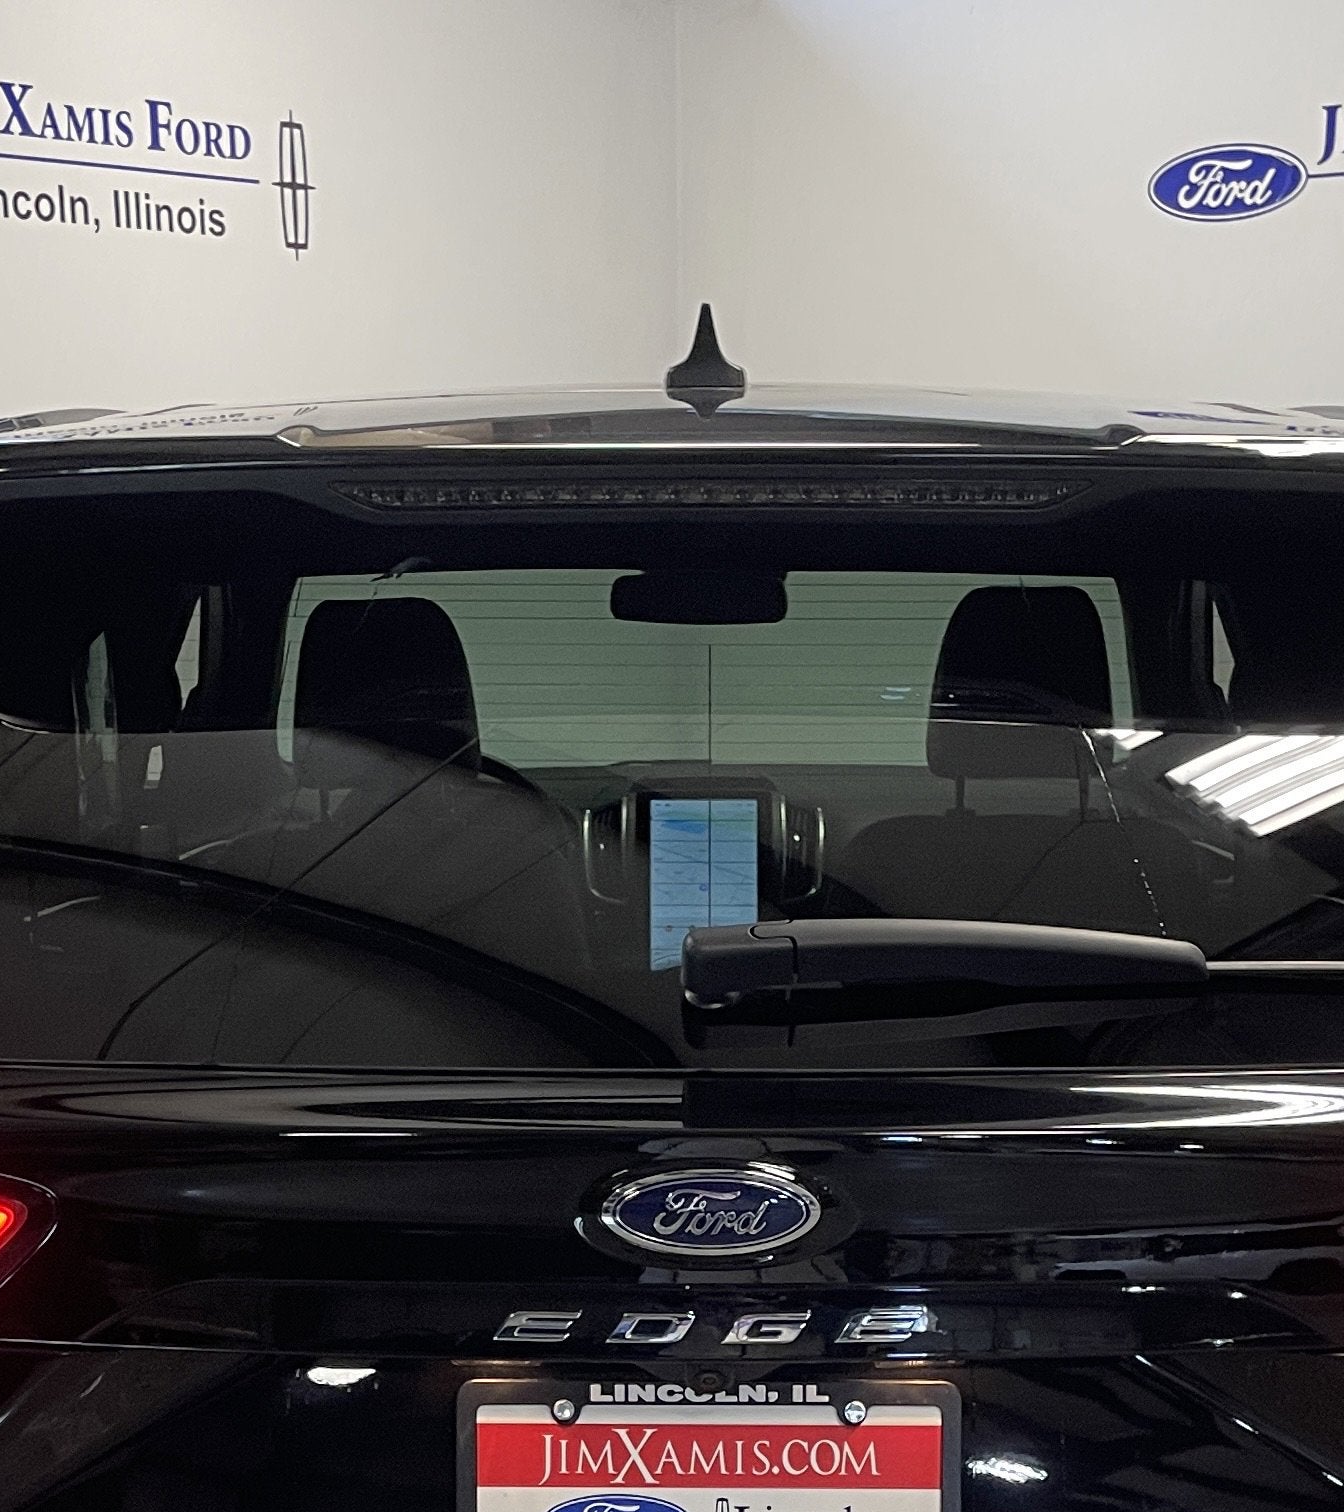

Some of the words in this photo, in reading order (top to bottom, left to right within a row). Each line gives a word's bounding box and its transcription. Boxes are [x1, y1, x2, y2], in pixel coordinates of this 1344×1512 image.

[144, 99, 252, 160] FORD
[1177, 158, 1275, 209] Ford
[113, 189, 226, 237] Illinois
[653, 1189, 776, 1236] Ford
[492, 1305, 928, 1344] EDGE
[792, 1384, 830, 1403] IL
[538, 1427, 882, 1486] JIMXAMIS.COM
